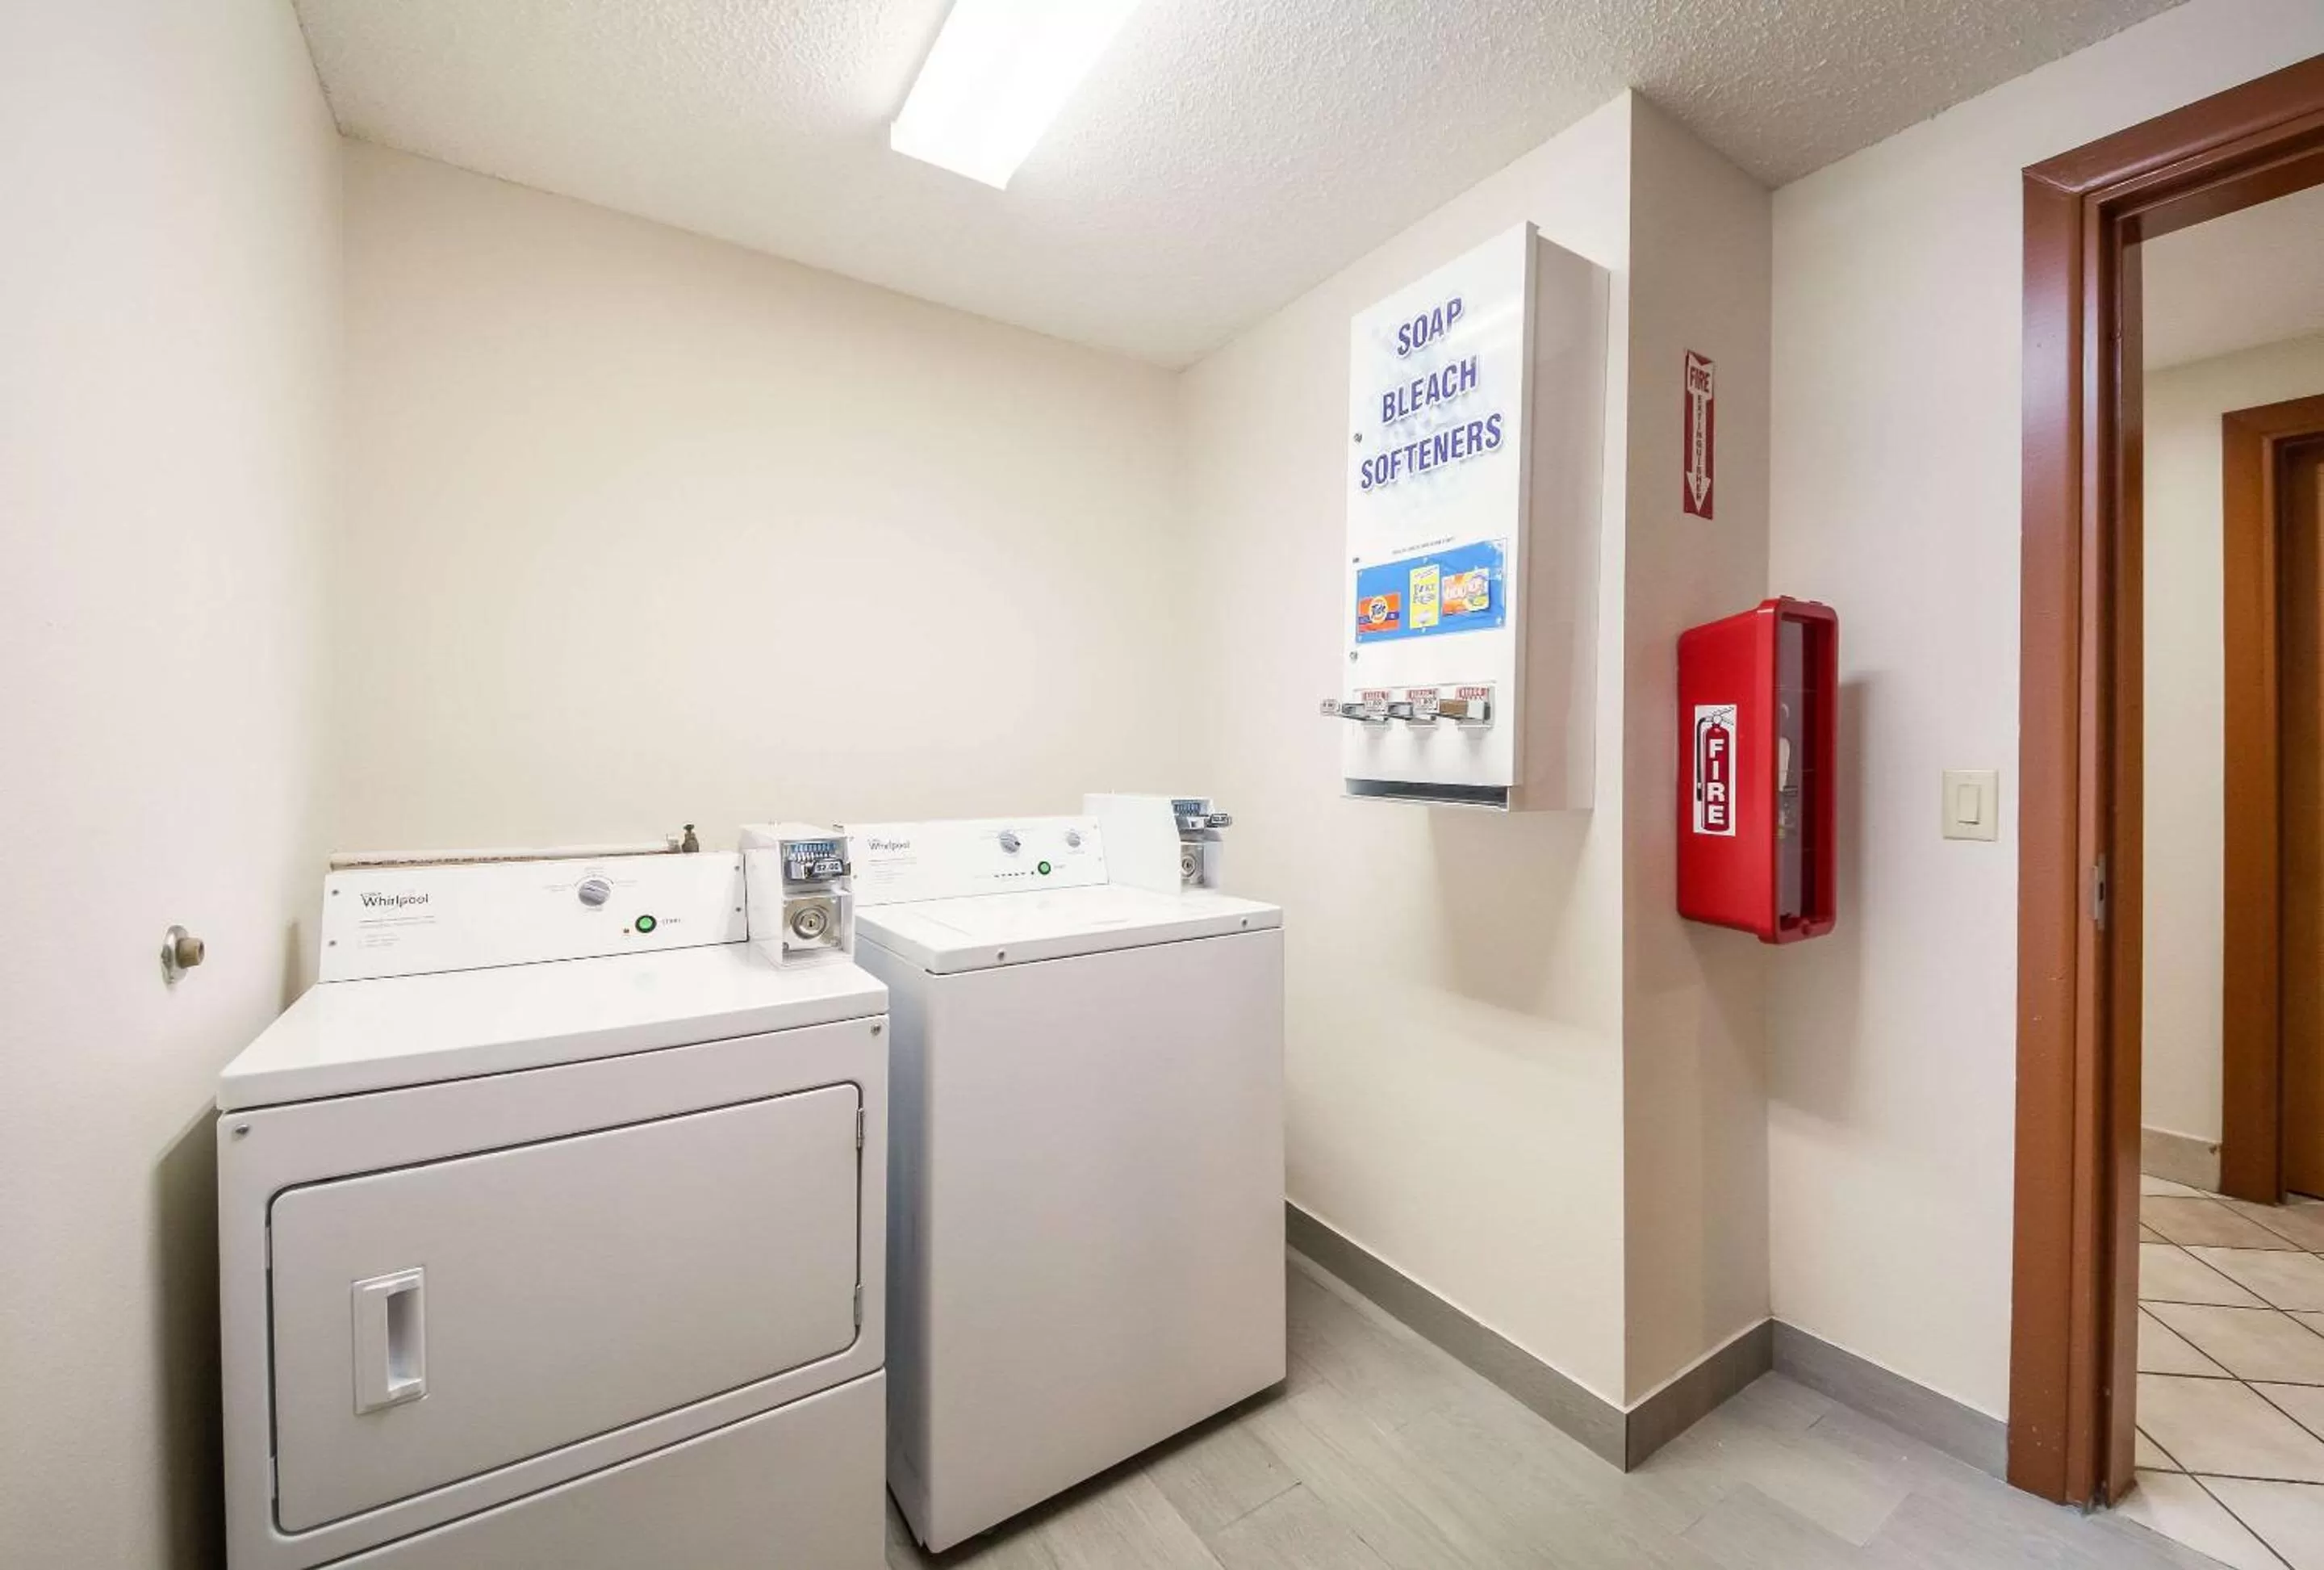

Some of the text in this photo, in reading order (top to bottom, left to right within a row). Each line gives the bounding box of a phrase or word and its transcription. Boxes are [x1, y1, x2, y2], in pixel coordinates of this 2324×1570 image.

[1396, 297, 1463, 356] SOAP
[1381, 354, 1478, 425] BLEACH
[1690, 365, 1711, 394] FIRE
[1360, 412, 1503, 490] SOFTENERS
[1707, 738, 1726, 826] FIRE
[361, 892, 429, 908] Whirlpool
